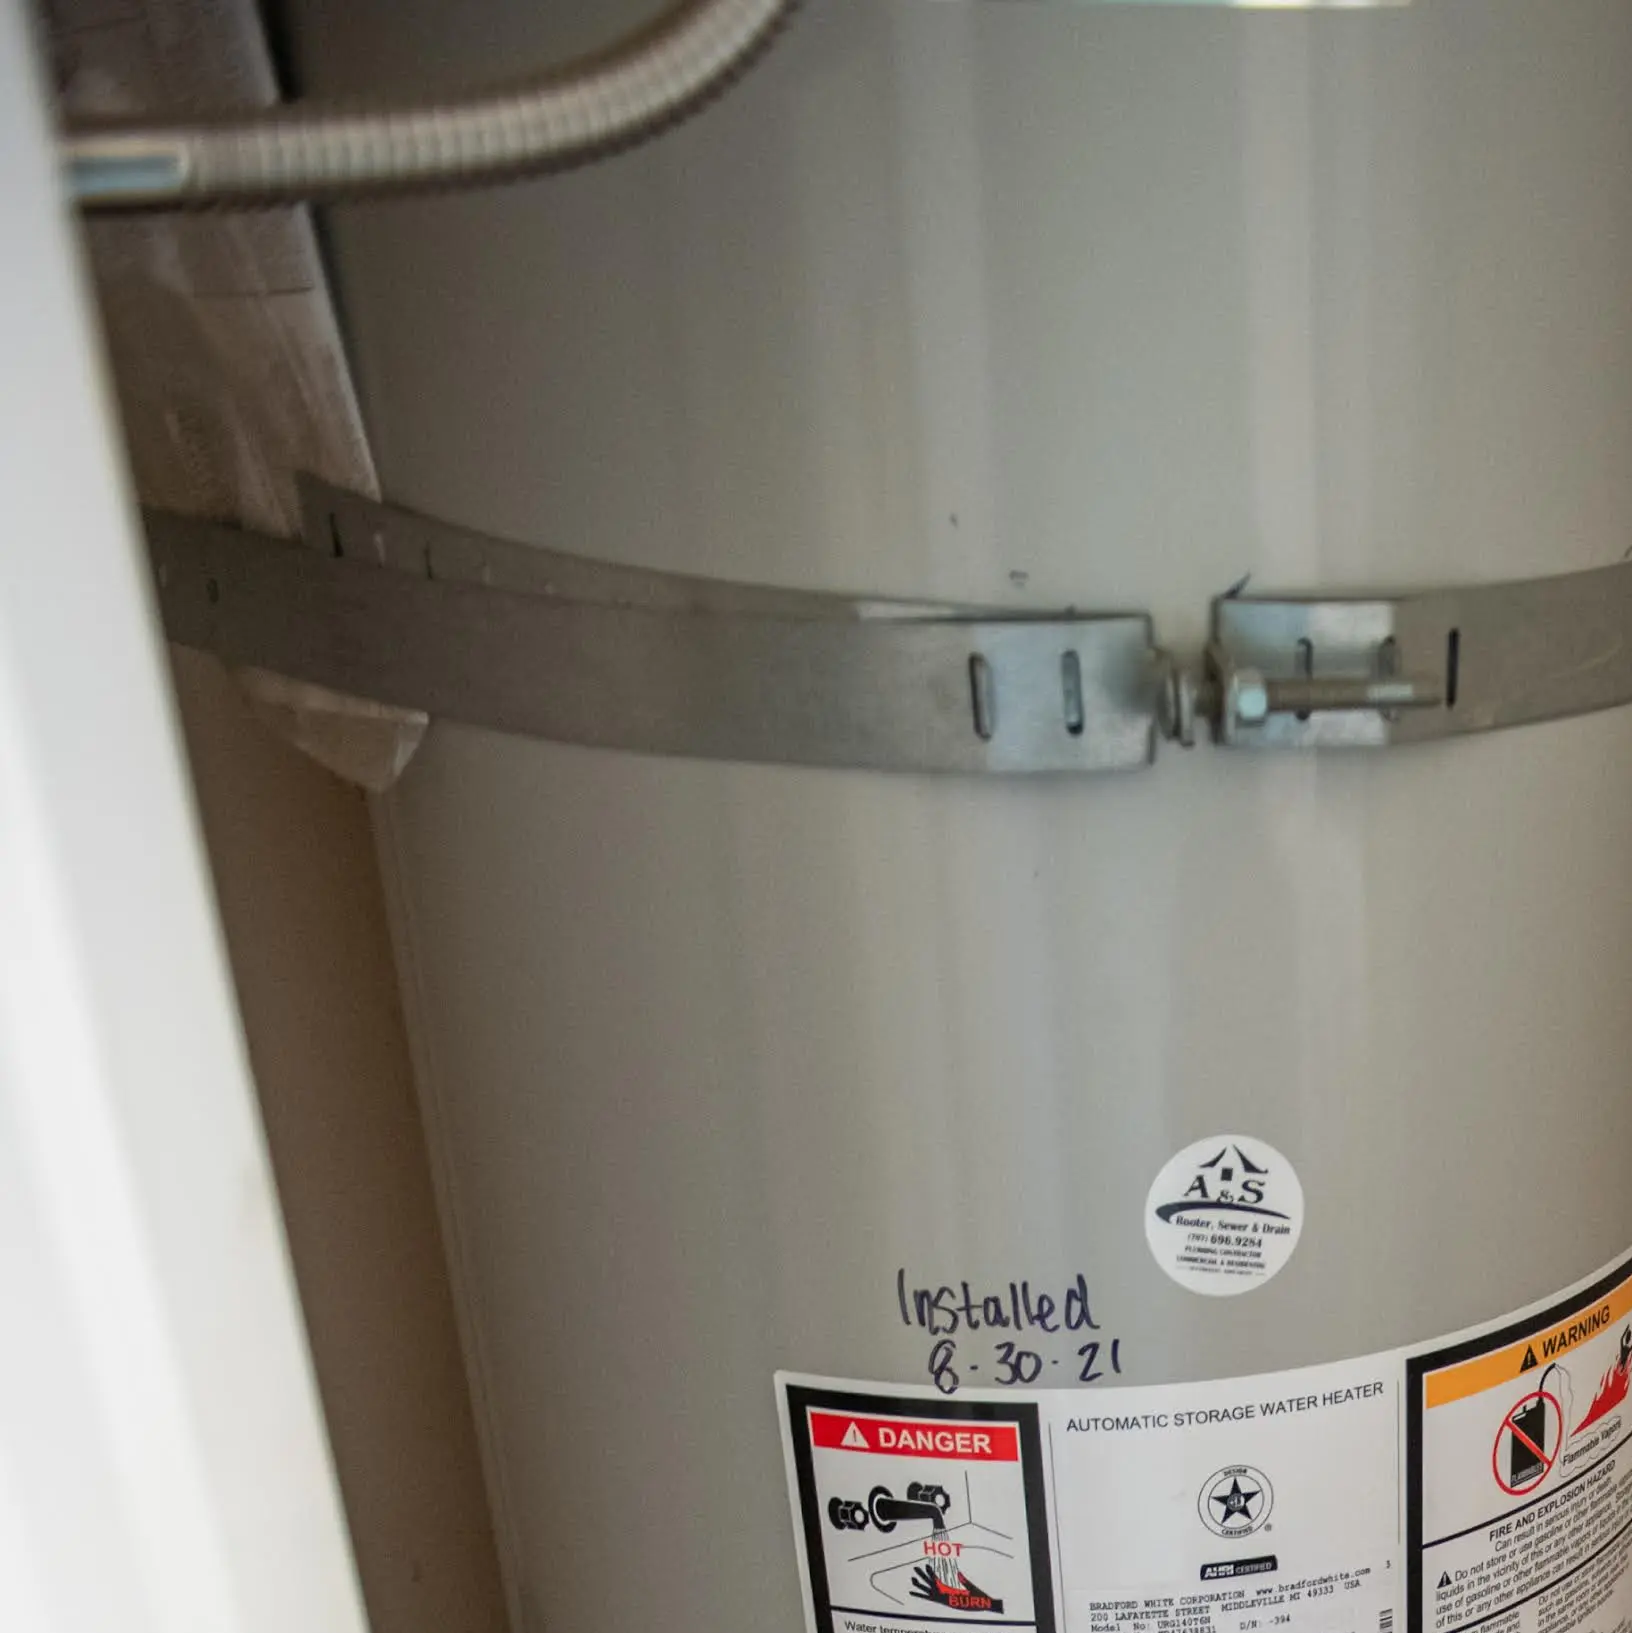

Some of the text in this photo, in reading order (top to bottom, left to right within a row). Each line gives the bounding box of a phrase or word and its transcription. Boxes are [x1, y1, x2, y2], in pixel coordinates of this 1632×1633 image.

[1218, 1220, 1248, 1232] Sewer
[1262, 1223, 1291, 1235] Drain
[898, 1268, 1100, 1336] Installed
[1542, 1305, 1610, 1358] WARNING
[1067, 1381, 1384, 1432] AUTOMATIC STORAGE WATER HEATER
[878, 1427, 992, 1454] DANGER
[1562, 1437, 1599, 1465] Flammable
[1489, 1459, 1616, 1541] FIRE AND EXPLOSION HAZARD
[923, 1541, 963, 1557] HOT
[1455, 1570, 1468, 1581] Do
[1470, 1562, 1484, 1575] not
[1486, 1554, 1507, 1569] store
[949, 1596, 992, 1608] BURN
[1090, 1567, 1371, 1611] BRADFORD WHITE CORPORATION www.bradfordwhite.com
[1091, 1580, 1360, 1622] 200 LAFAYETTE STREET MIDDLEVILLE MI 49333 USA
[845, 1621, 877, 1633] Water
[1091, 1623, 1120, 1632] Model
